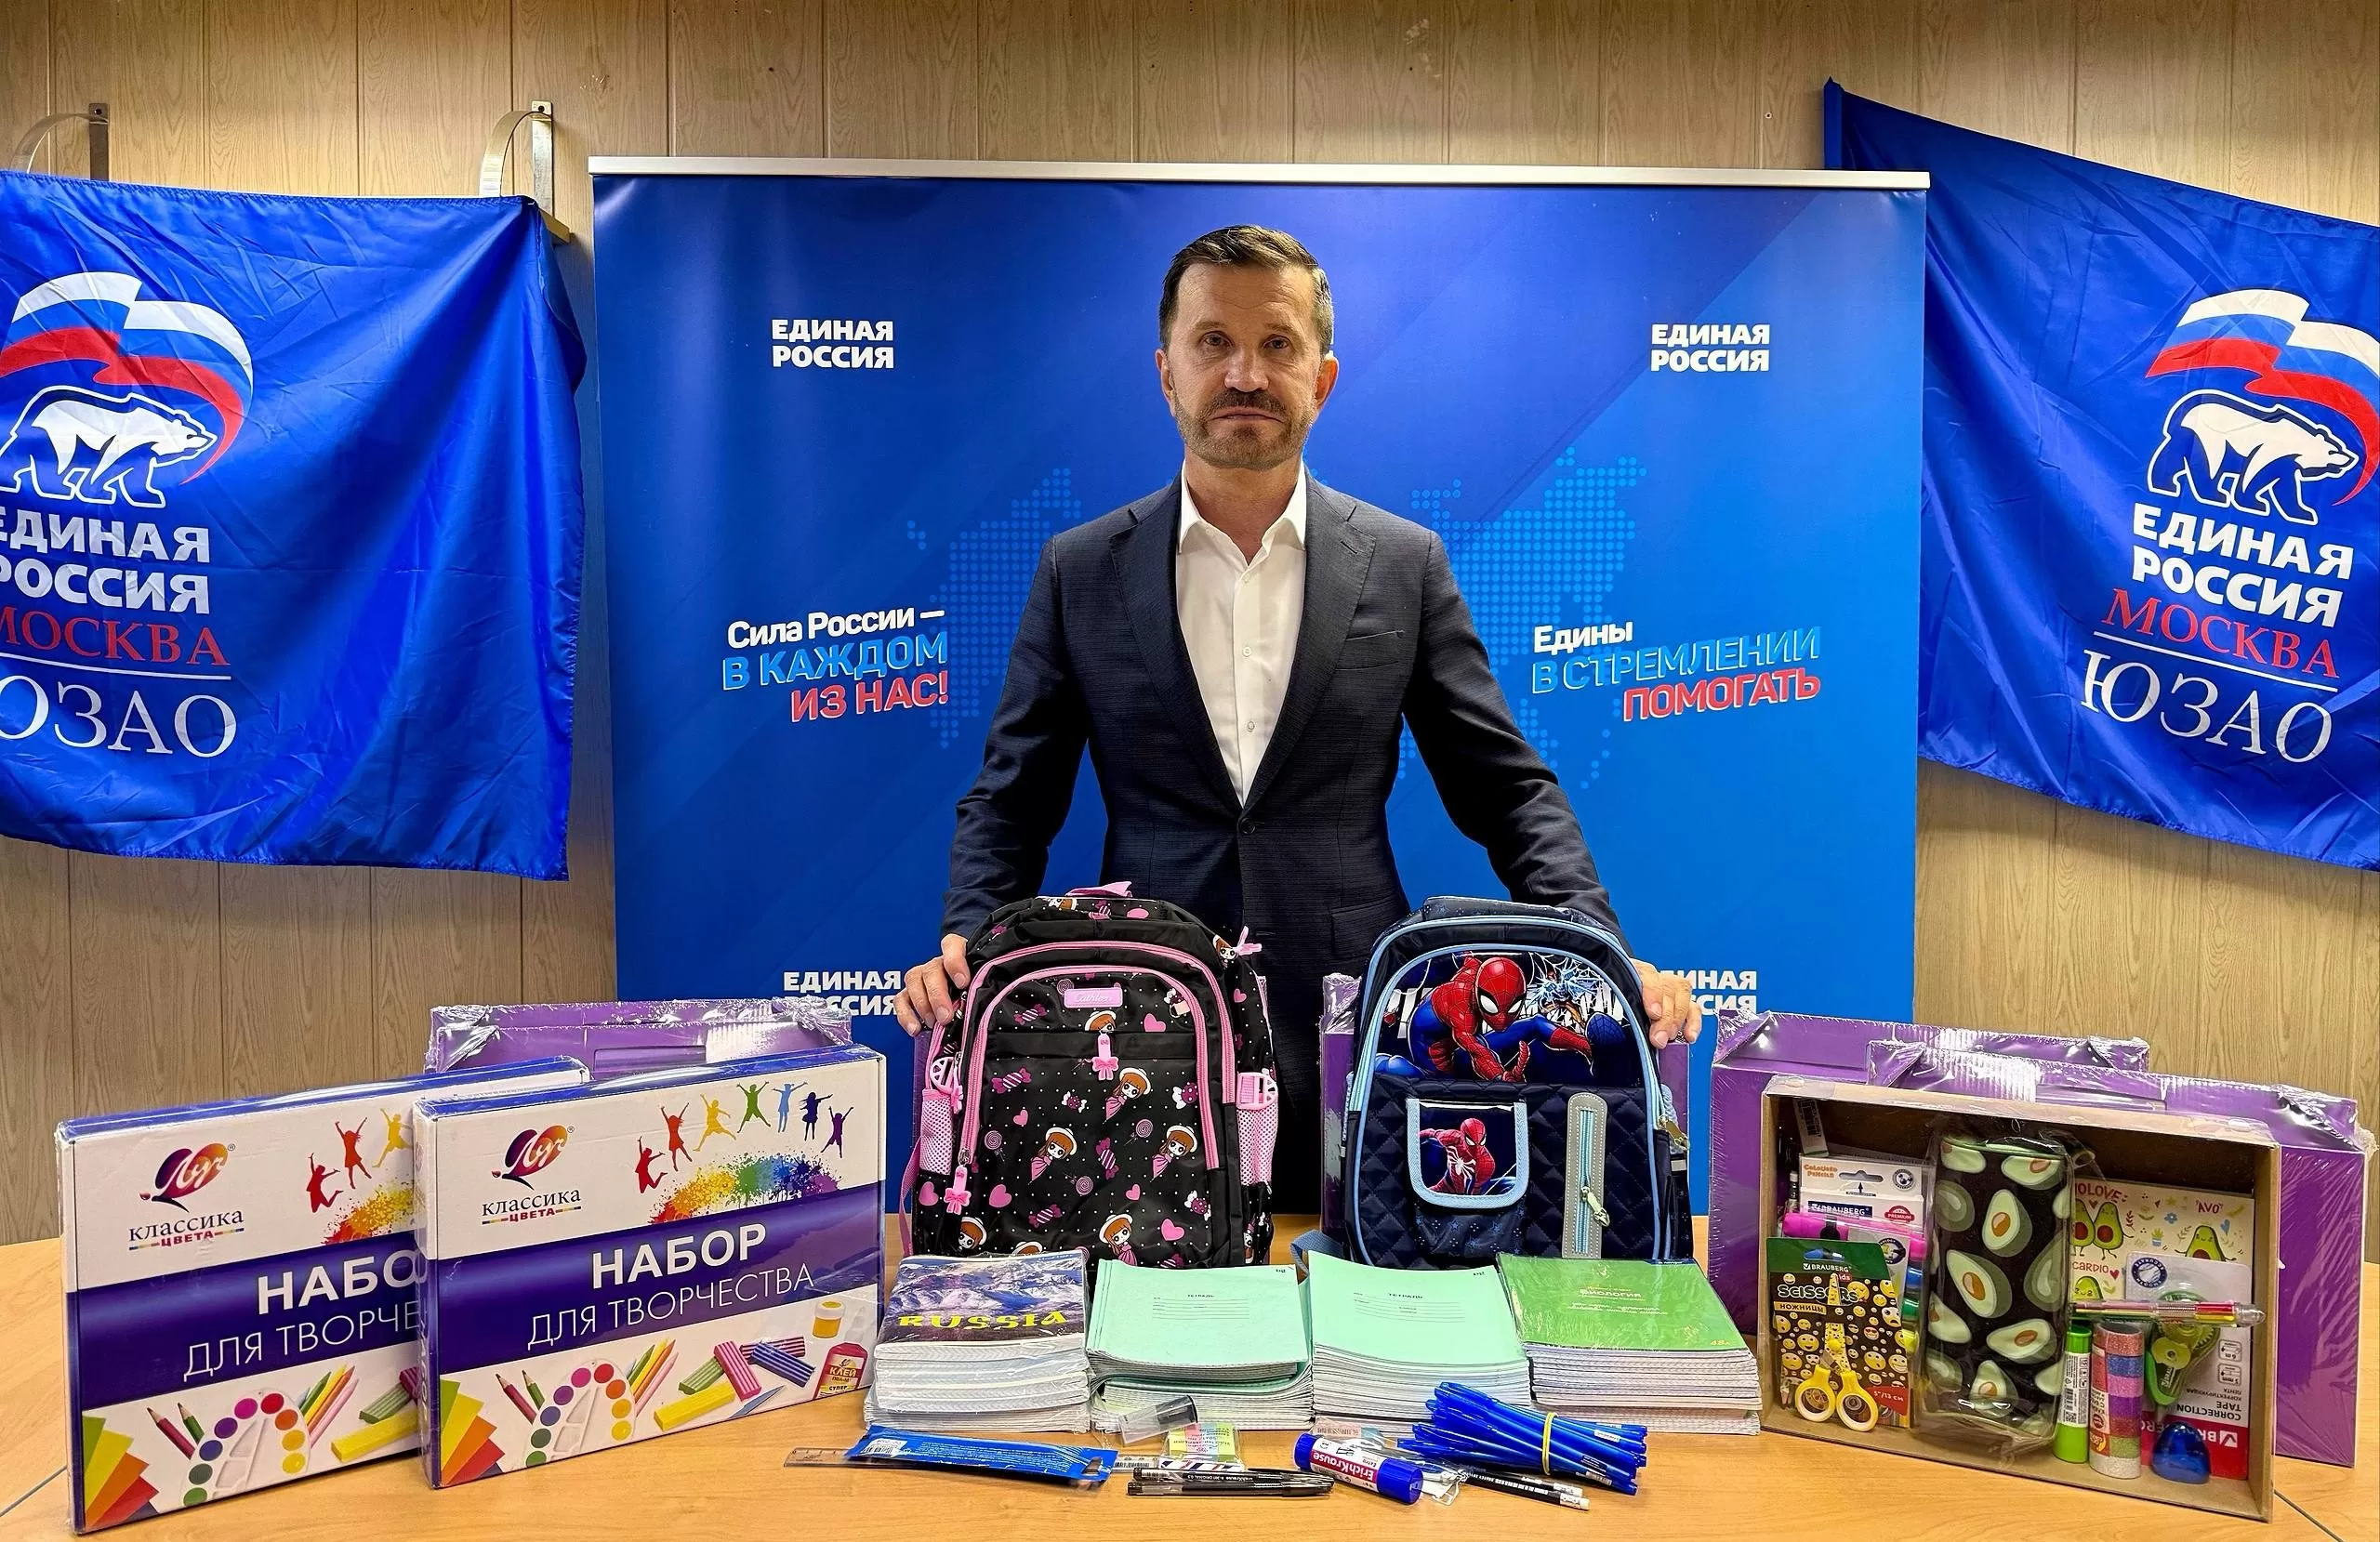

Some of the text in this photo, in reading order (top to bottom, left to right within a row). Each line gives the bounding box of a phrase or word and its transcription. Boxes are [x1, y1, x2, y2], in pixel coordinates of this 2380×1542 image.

[772, 319, 893, 342] ЕДИНАЯ
[1651, 323, 1770, 348] ЕДИНАЯ
[773, 345, 894, 369] РОССИЯ
[1650, 349, 1770, 372] РОССИЯ
[0, 506, 210, 563] ДИНАЯ
[2133, 502, 2354, 581] ЕДИНАЯ
[2132, 545, 2344, 628] РОССИЯ
[727, 620, 803, 649] Сила
[808, 607, 915, 639] России
[1534, 621, 1633, 655] Едины
[2101, 587, 2340, 679] МОСКВА
[722, 631, 948, 691] В КАЖДОМ
[1532, 626, 1821, 694] В СТРЕМЛЕНИИ
[791, 669, 949, 723] ИЗ НАС!
[1623, 667, 1821, 722] ПОМОГАТЬ
[2080, 649, 2333, 763] ЮЗАО
[784, 970, 901, 993] ЕДИНАЯ
[482, 1189, 581, 1217] классика
[509, 1207, 556, 1222] ЦВЕТА
[128, 1209, 245, 1242] классика
[161, 1230, 214, 1247] ЦВЕТА
[592, 1222, 767, 1290] НАБОР
[1811, 1263, 1849, 1272] BRAUBERG
[527, 1262, 816, 1351] ДЛЯ ТВОРЧЕСТВА
[1777, 1284, 1860, 1303] SCISSRS
[1779, 1303, 1825, 1313] НОЖНИЦЫ
[897, 1310, 1069, 1331] RUSSIA
[183, 1332, 263, 1383] ДЛЯ
[2176, 1404, 2241, 1421] CORRECTION
[2216, 1401, 2241, 1412] TAPE
[1313, 1452, 1375, 1481] ErichKrause
